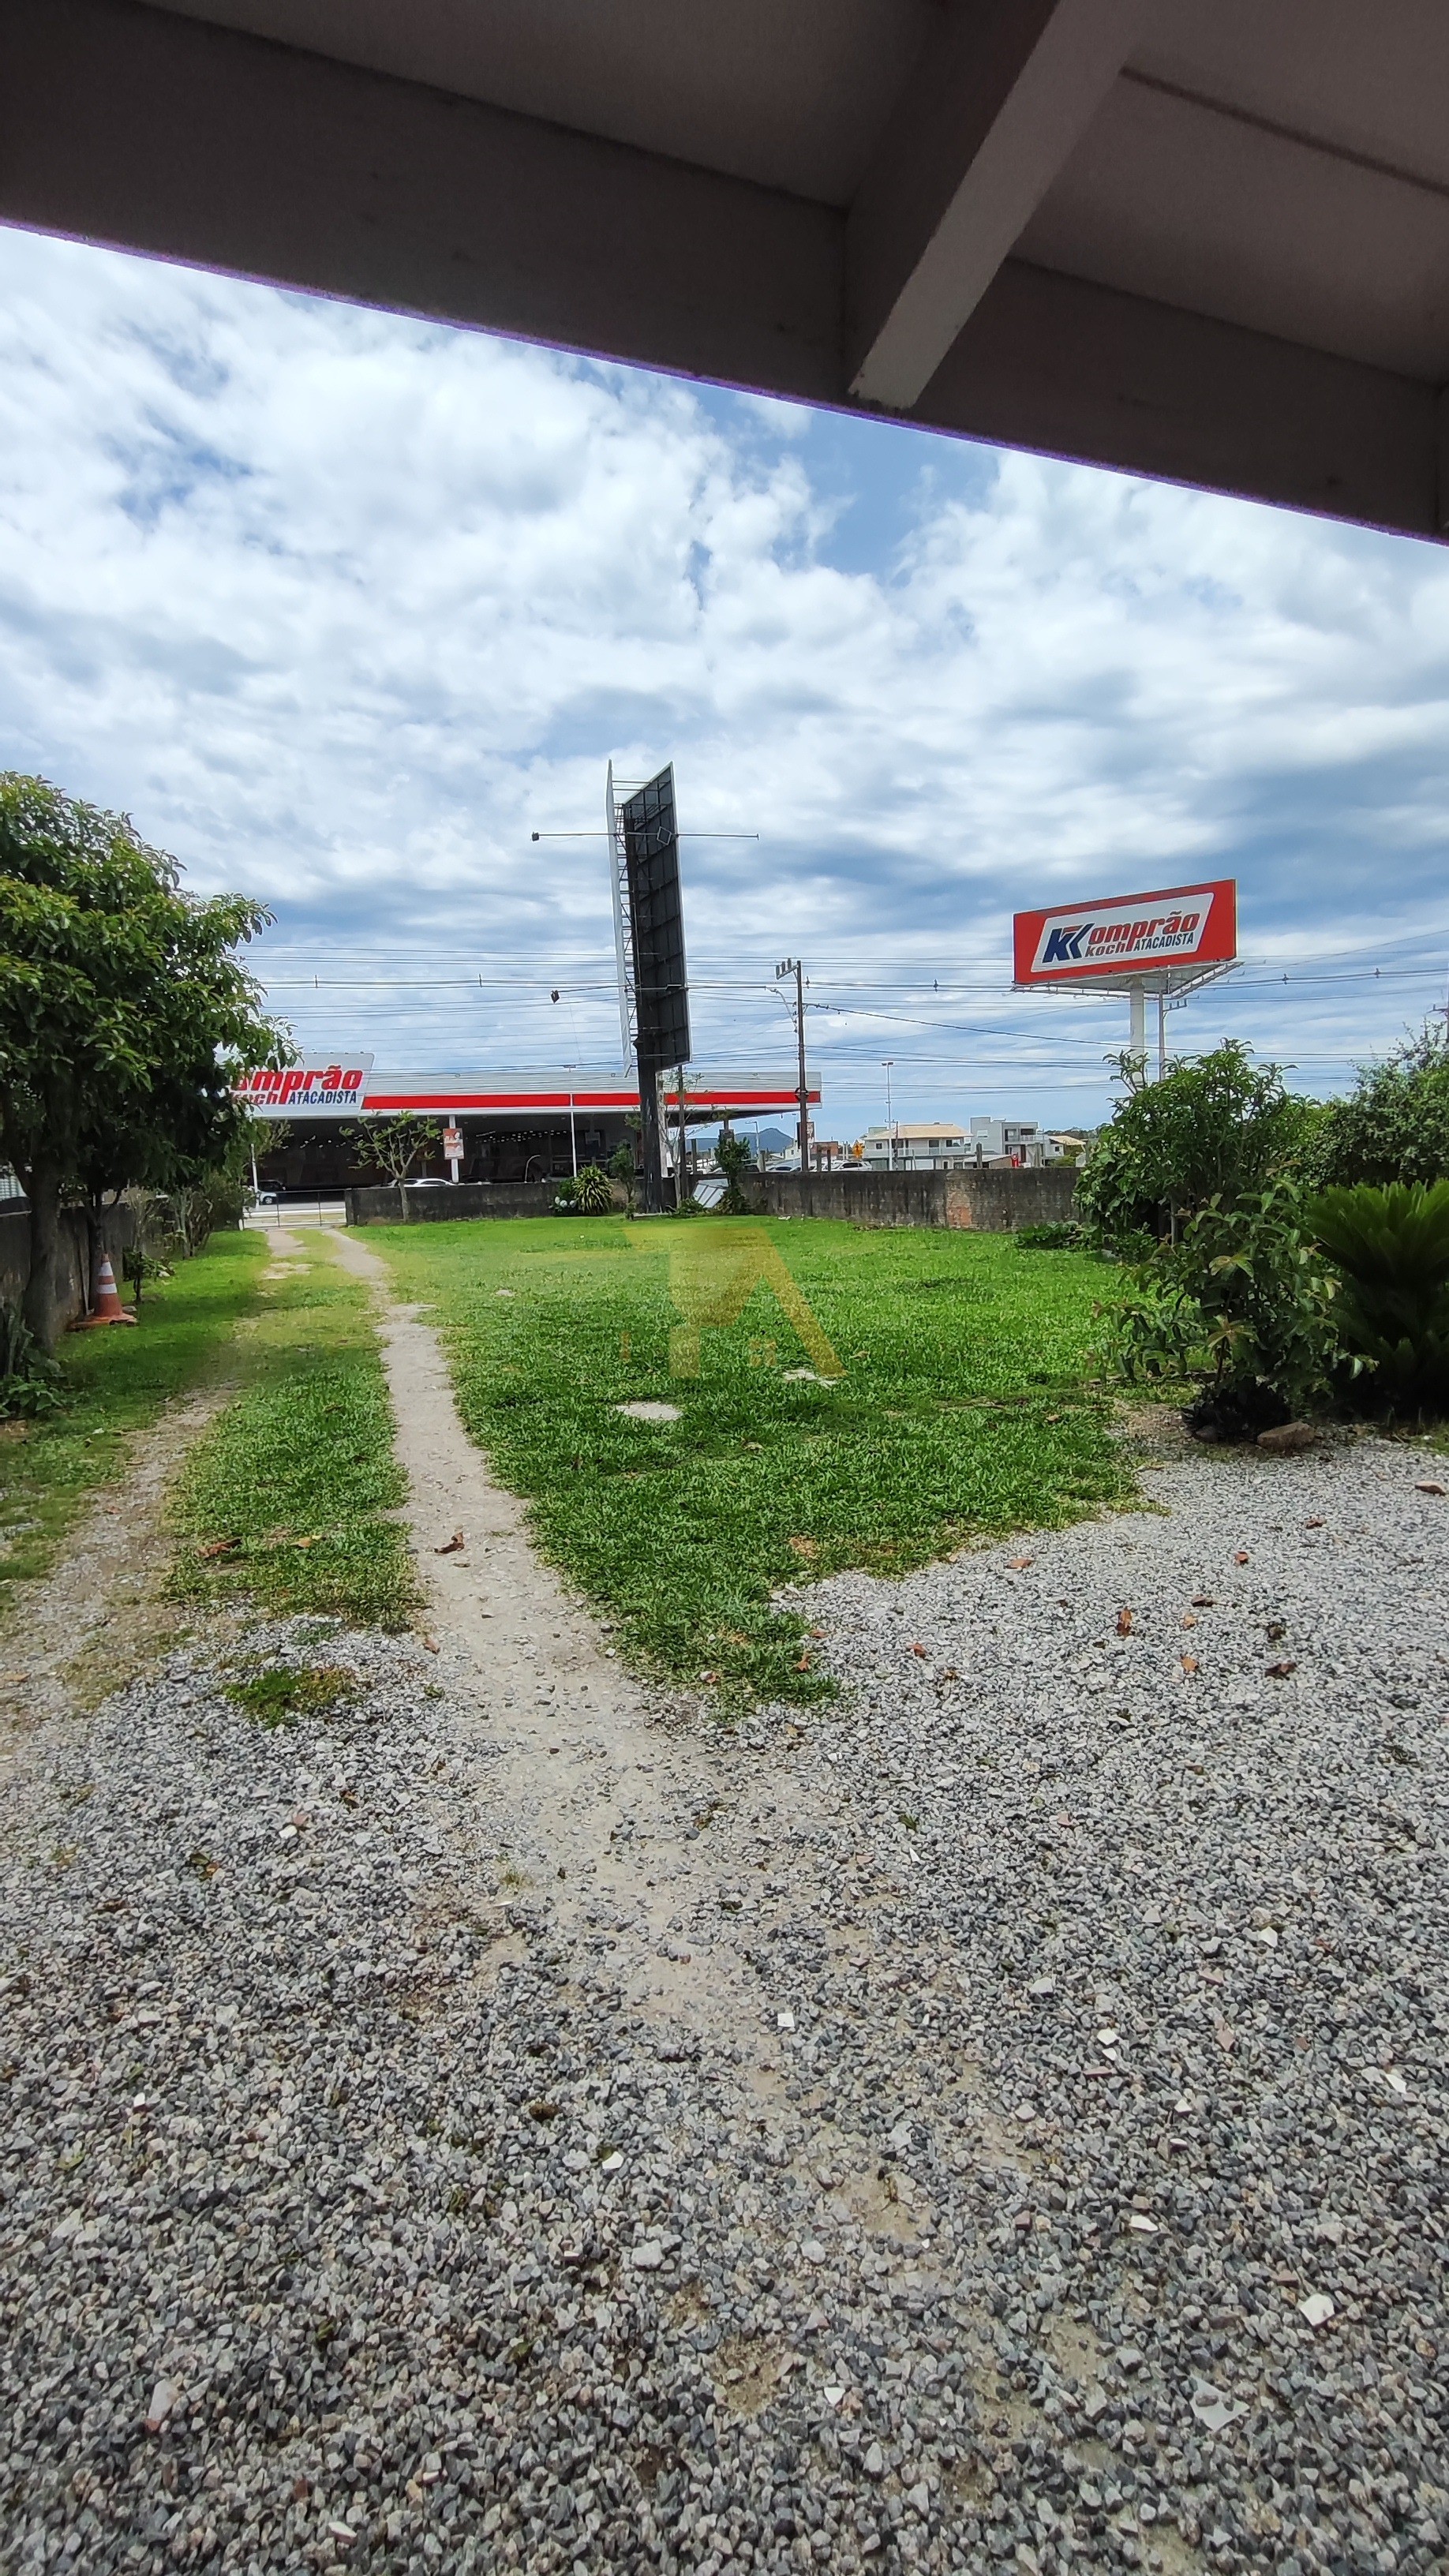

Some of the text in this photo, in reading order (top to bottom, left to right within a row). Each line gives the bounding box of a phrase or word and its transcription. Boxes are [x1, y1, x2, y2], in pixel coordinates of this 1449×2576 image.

[1042, 910, 1200, 963] Komprão
[1084, 932, 1194, 958] koch ATACADISTA
[288, 1090, 357, 1105] ATACADISTA
